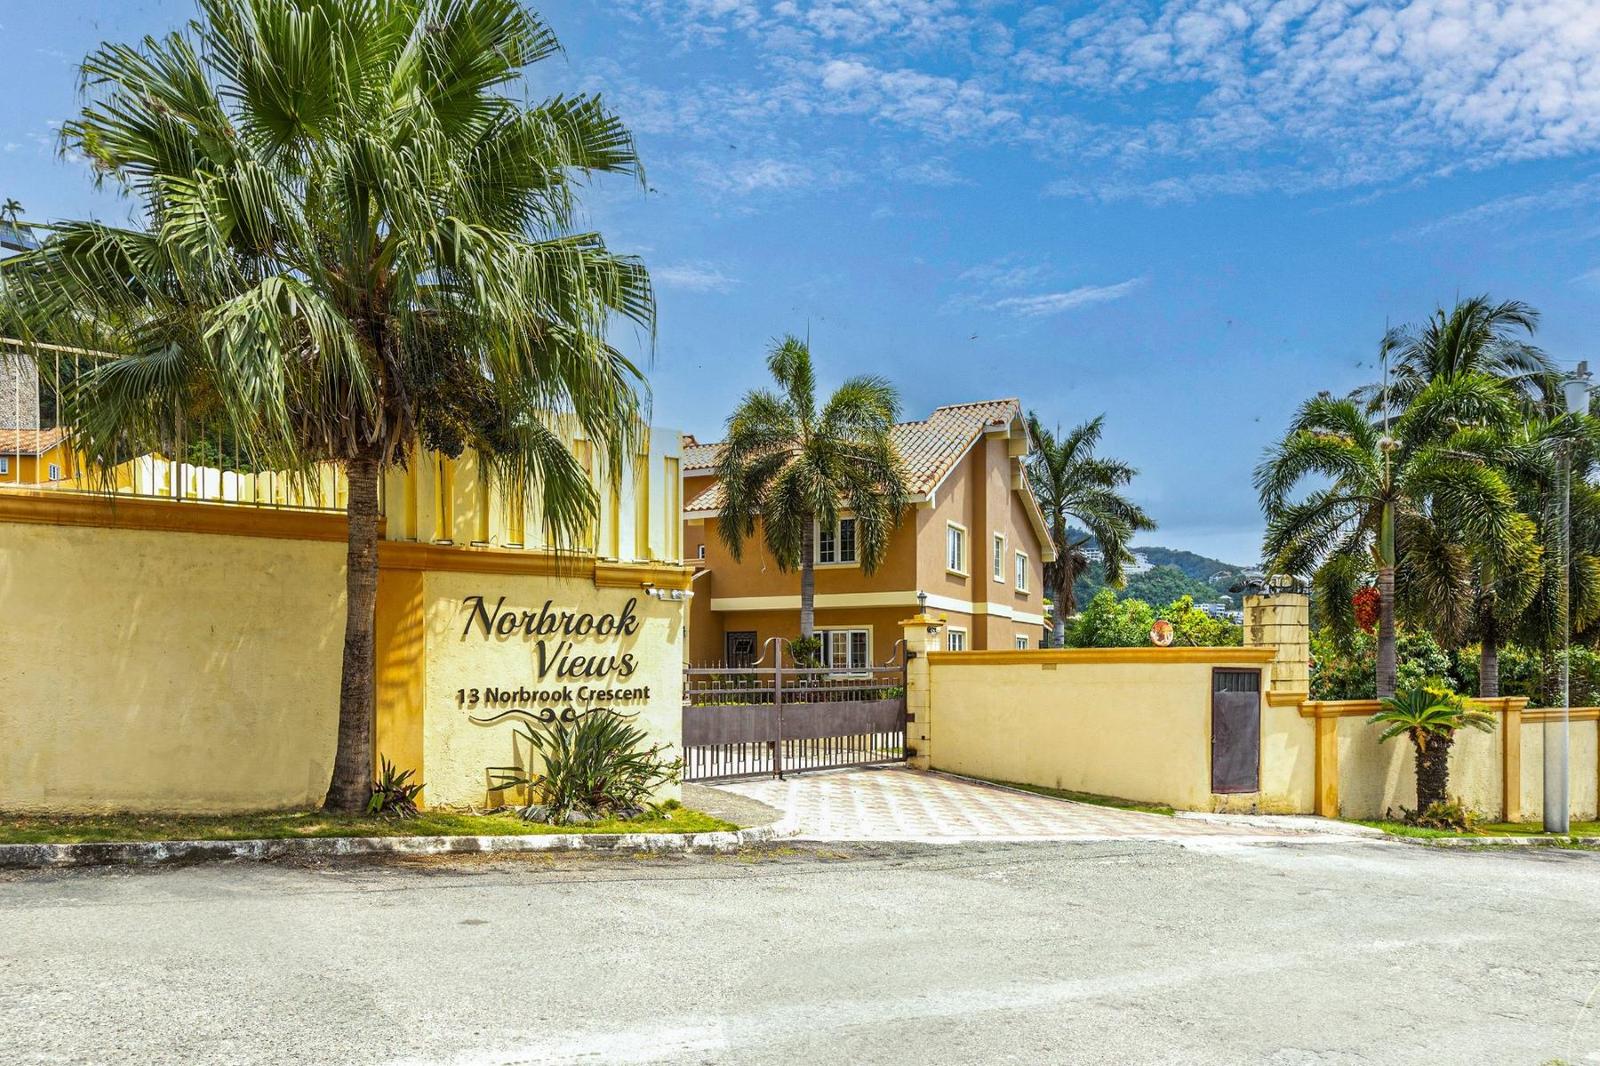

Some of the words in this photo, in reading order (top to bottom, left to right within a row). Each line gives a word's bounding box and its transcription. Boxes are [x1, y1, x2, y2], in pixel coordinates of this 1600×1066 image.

[463, 596, 639, 636] Norbrook
[536, 640, 639, 678] Views
[457, 688, 480, 704] 13
[485, 686, 572, 703] Norbrook
[577, 685, 651, 702] Crescent
